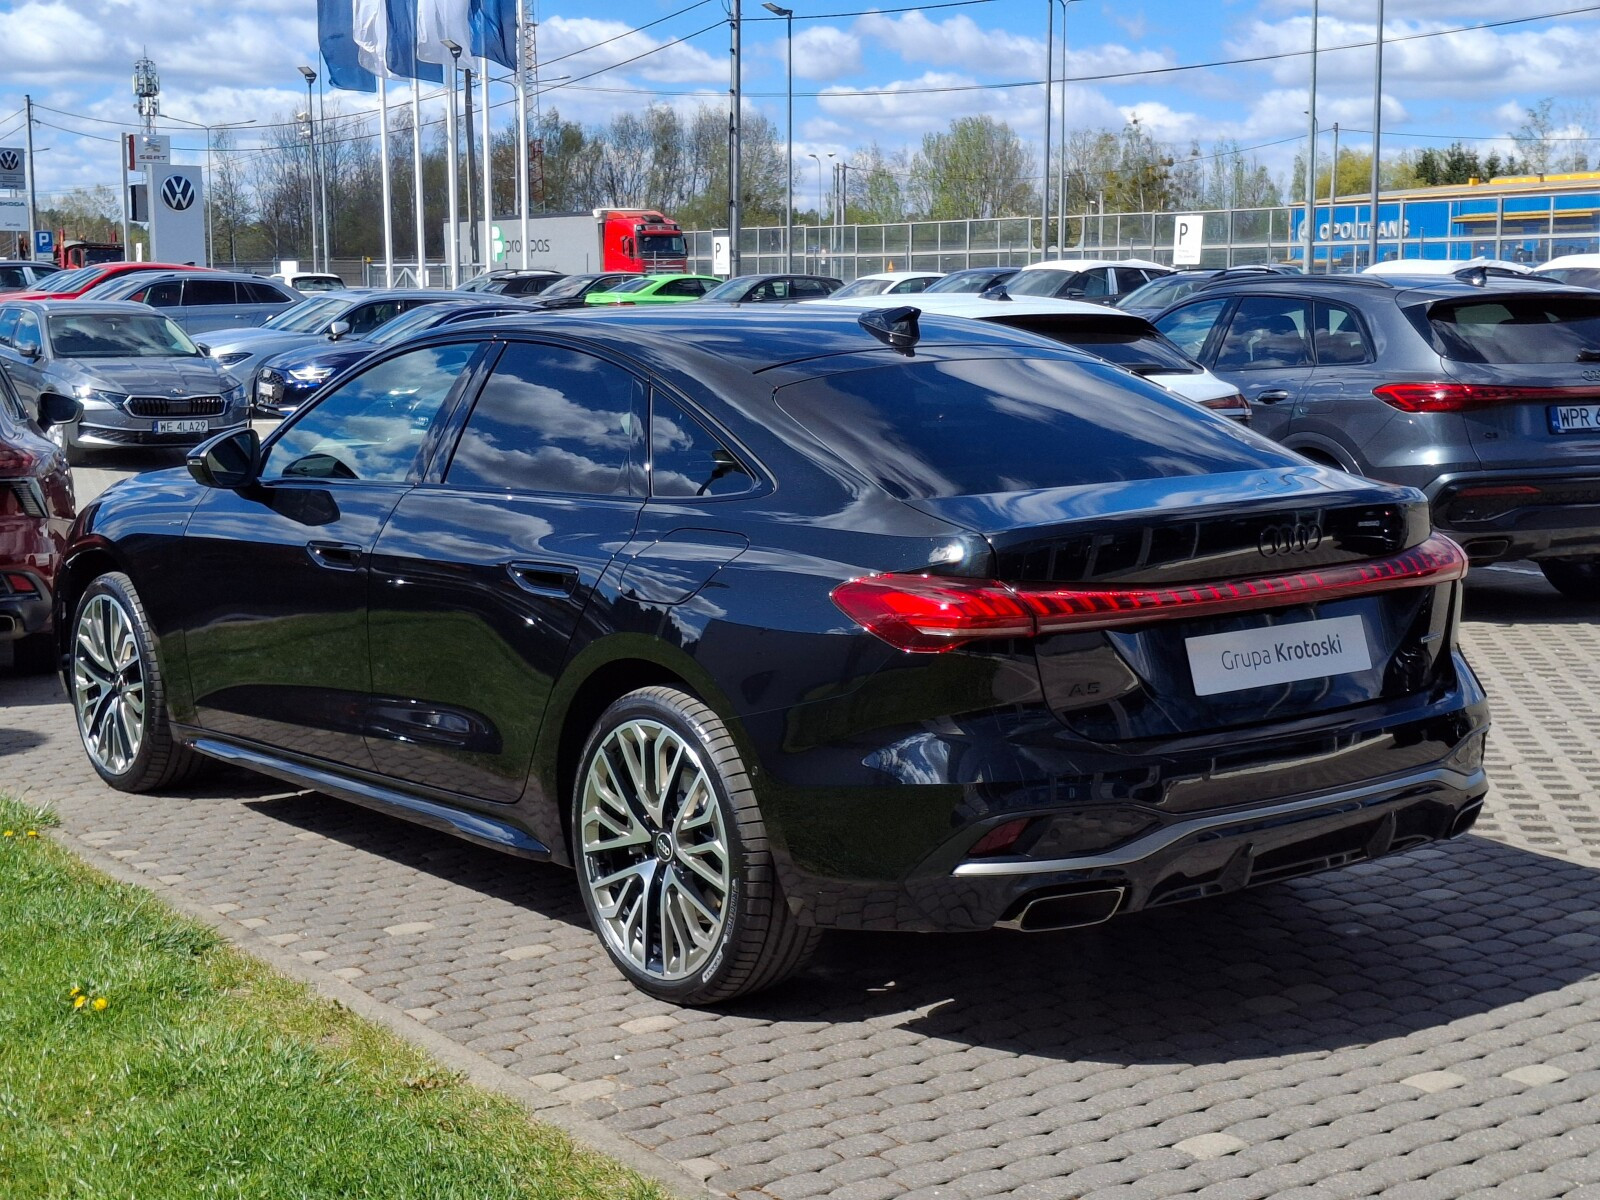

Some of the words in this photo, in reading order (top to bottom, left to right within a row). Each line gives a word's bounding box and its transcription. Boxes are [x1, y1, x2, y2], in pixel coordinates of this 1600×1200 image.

[39, 233, 49, 246] P
[1179, 223, 1188, 245] P
[715, 242, 721, 260] P
[160, 422, 173, 431] WE
[177, 421, 206, 431] 4LA29
[1559, 408, 1591, 427] WPR
[1221, 649, 1272, 671] Grupa
[1274, 633, 1343, 662] Krotoski
[1068, 682, 1100, 697] A5
